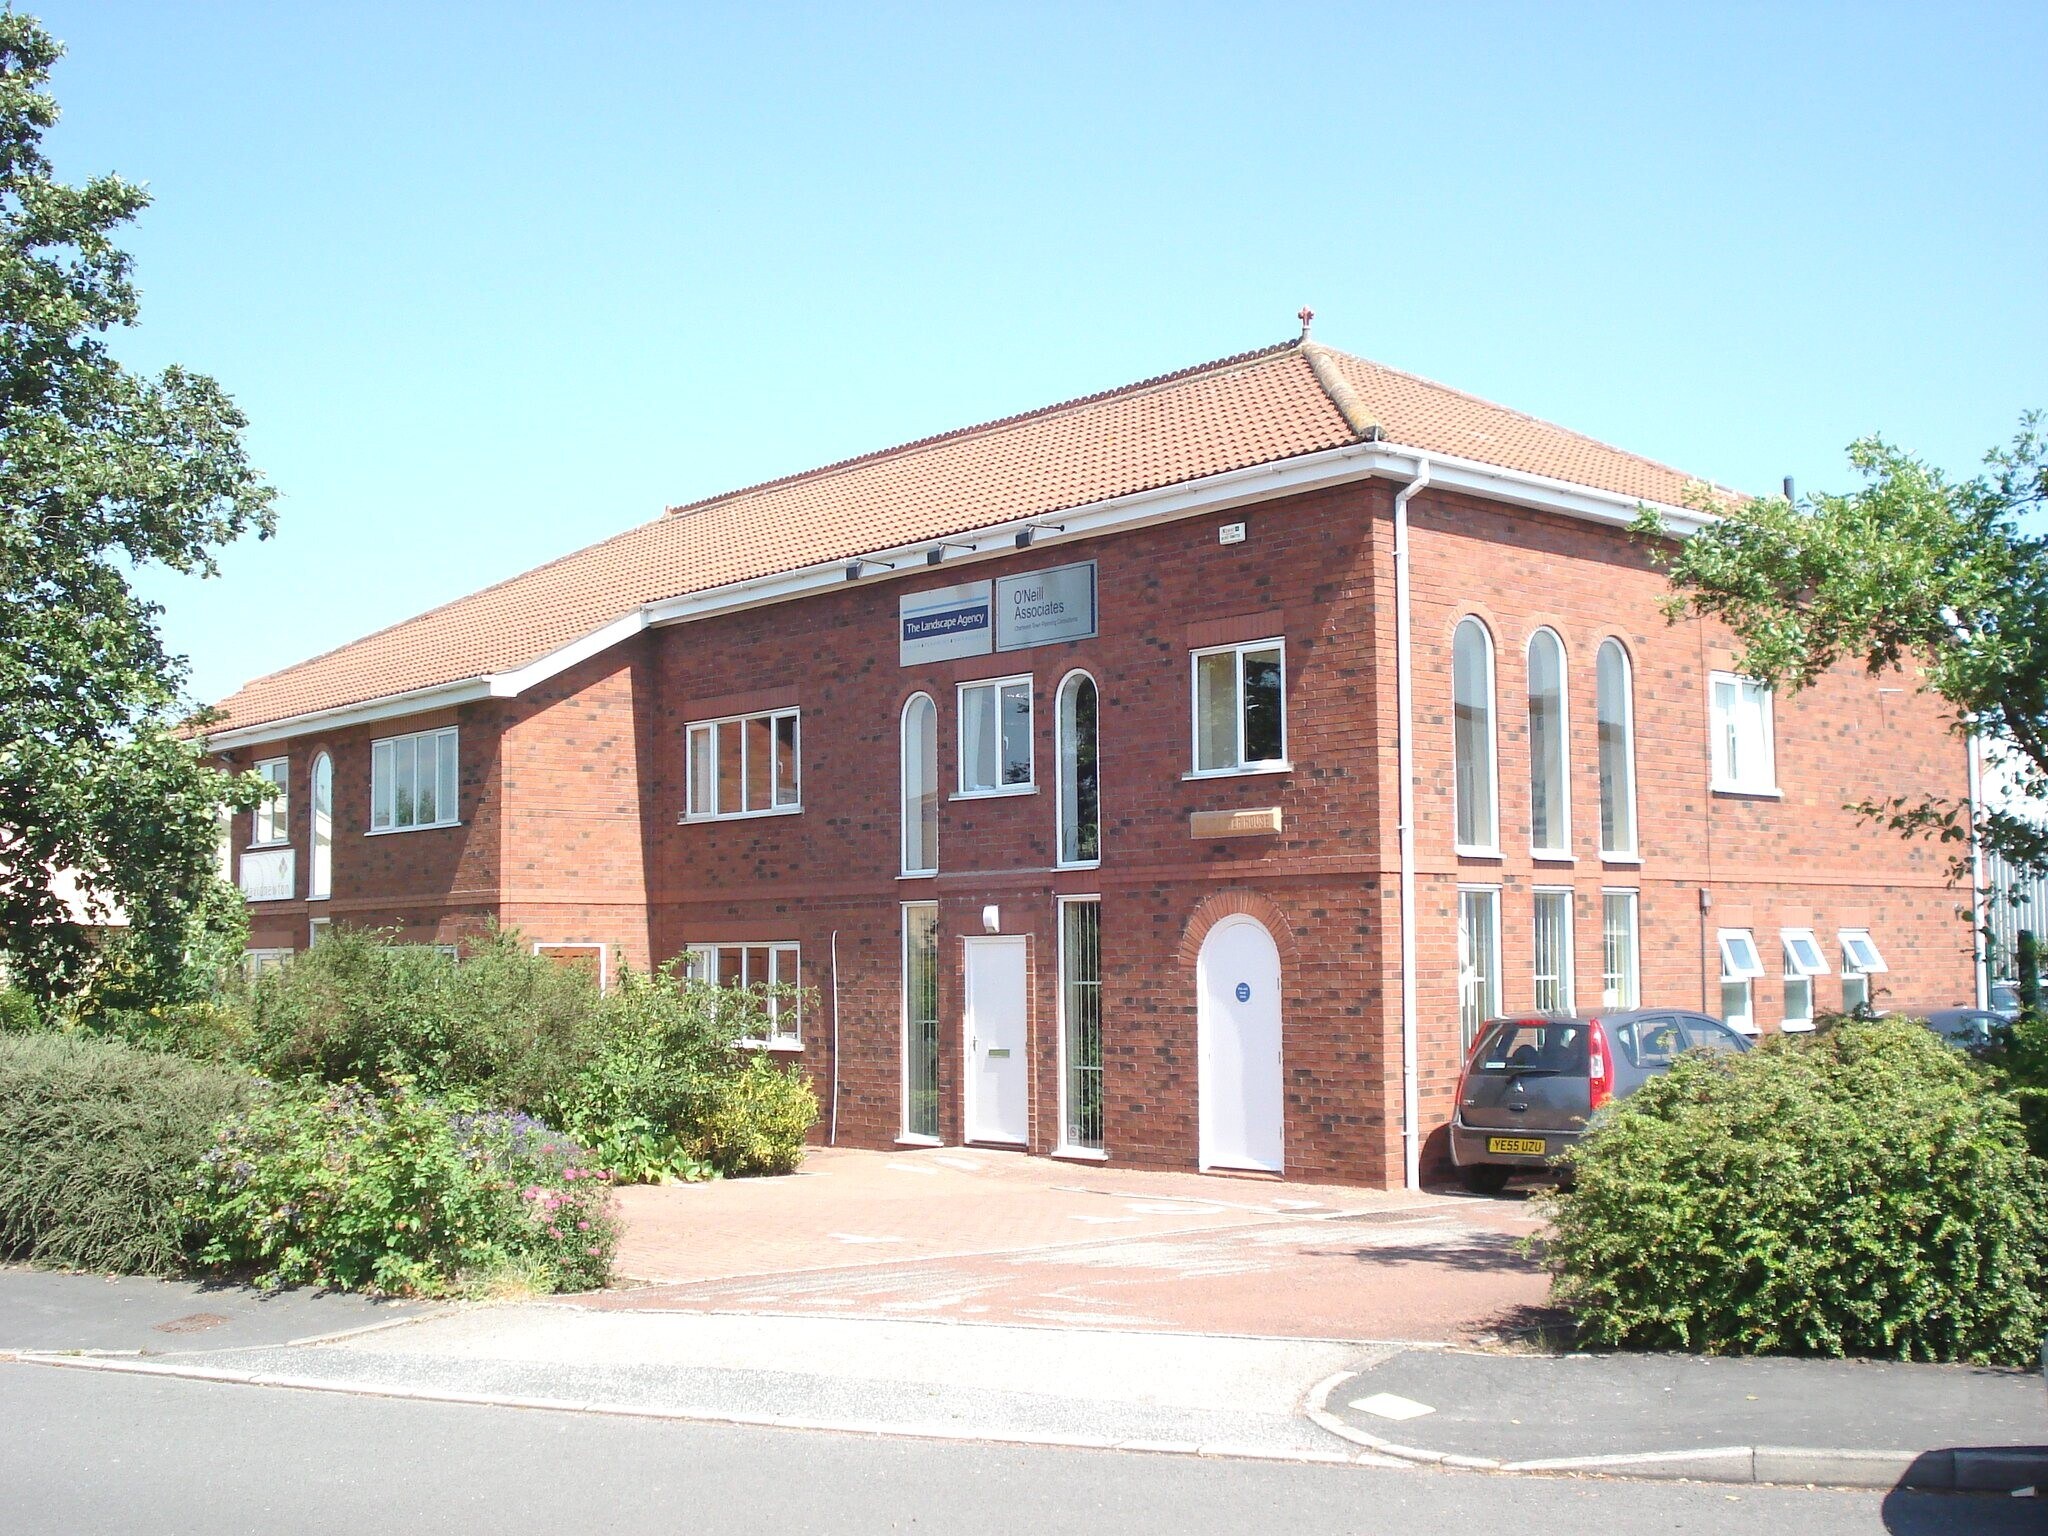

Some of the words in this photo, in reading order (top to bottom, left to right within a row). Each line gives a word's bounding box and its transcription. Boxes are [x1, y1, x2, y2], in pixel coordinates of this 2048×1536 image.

[1013, 586, 1044, 605] O'Neill
[1014, 601, 1065, 621] Associates
[906, 622, 921, 634] The
[921, 618, 957, 632] Landscape
[957, 612, 985, 628] Agency
[1494, 1139, 1520, 1151] YE55
[1521, 1141, 1542, 1153] UZU
